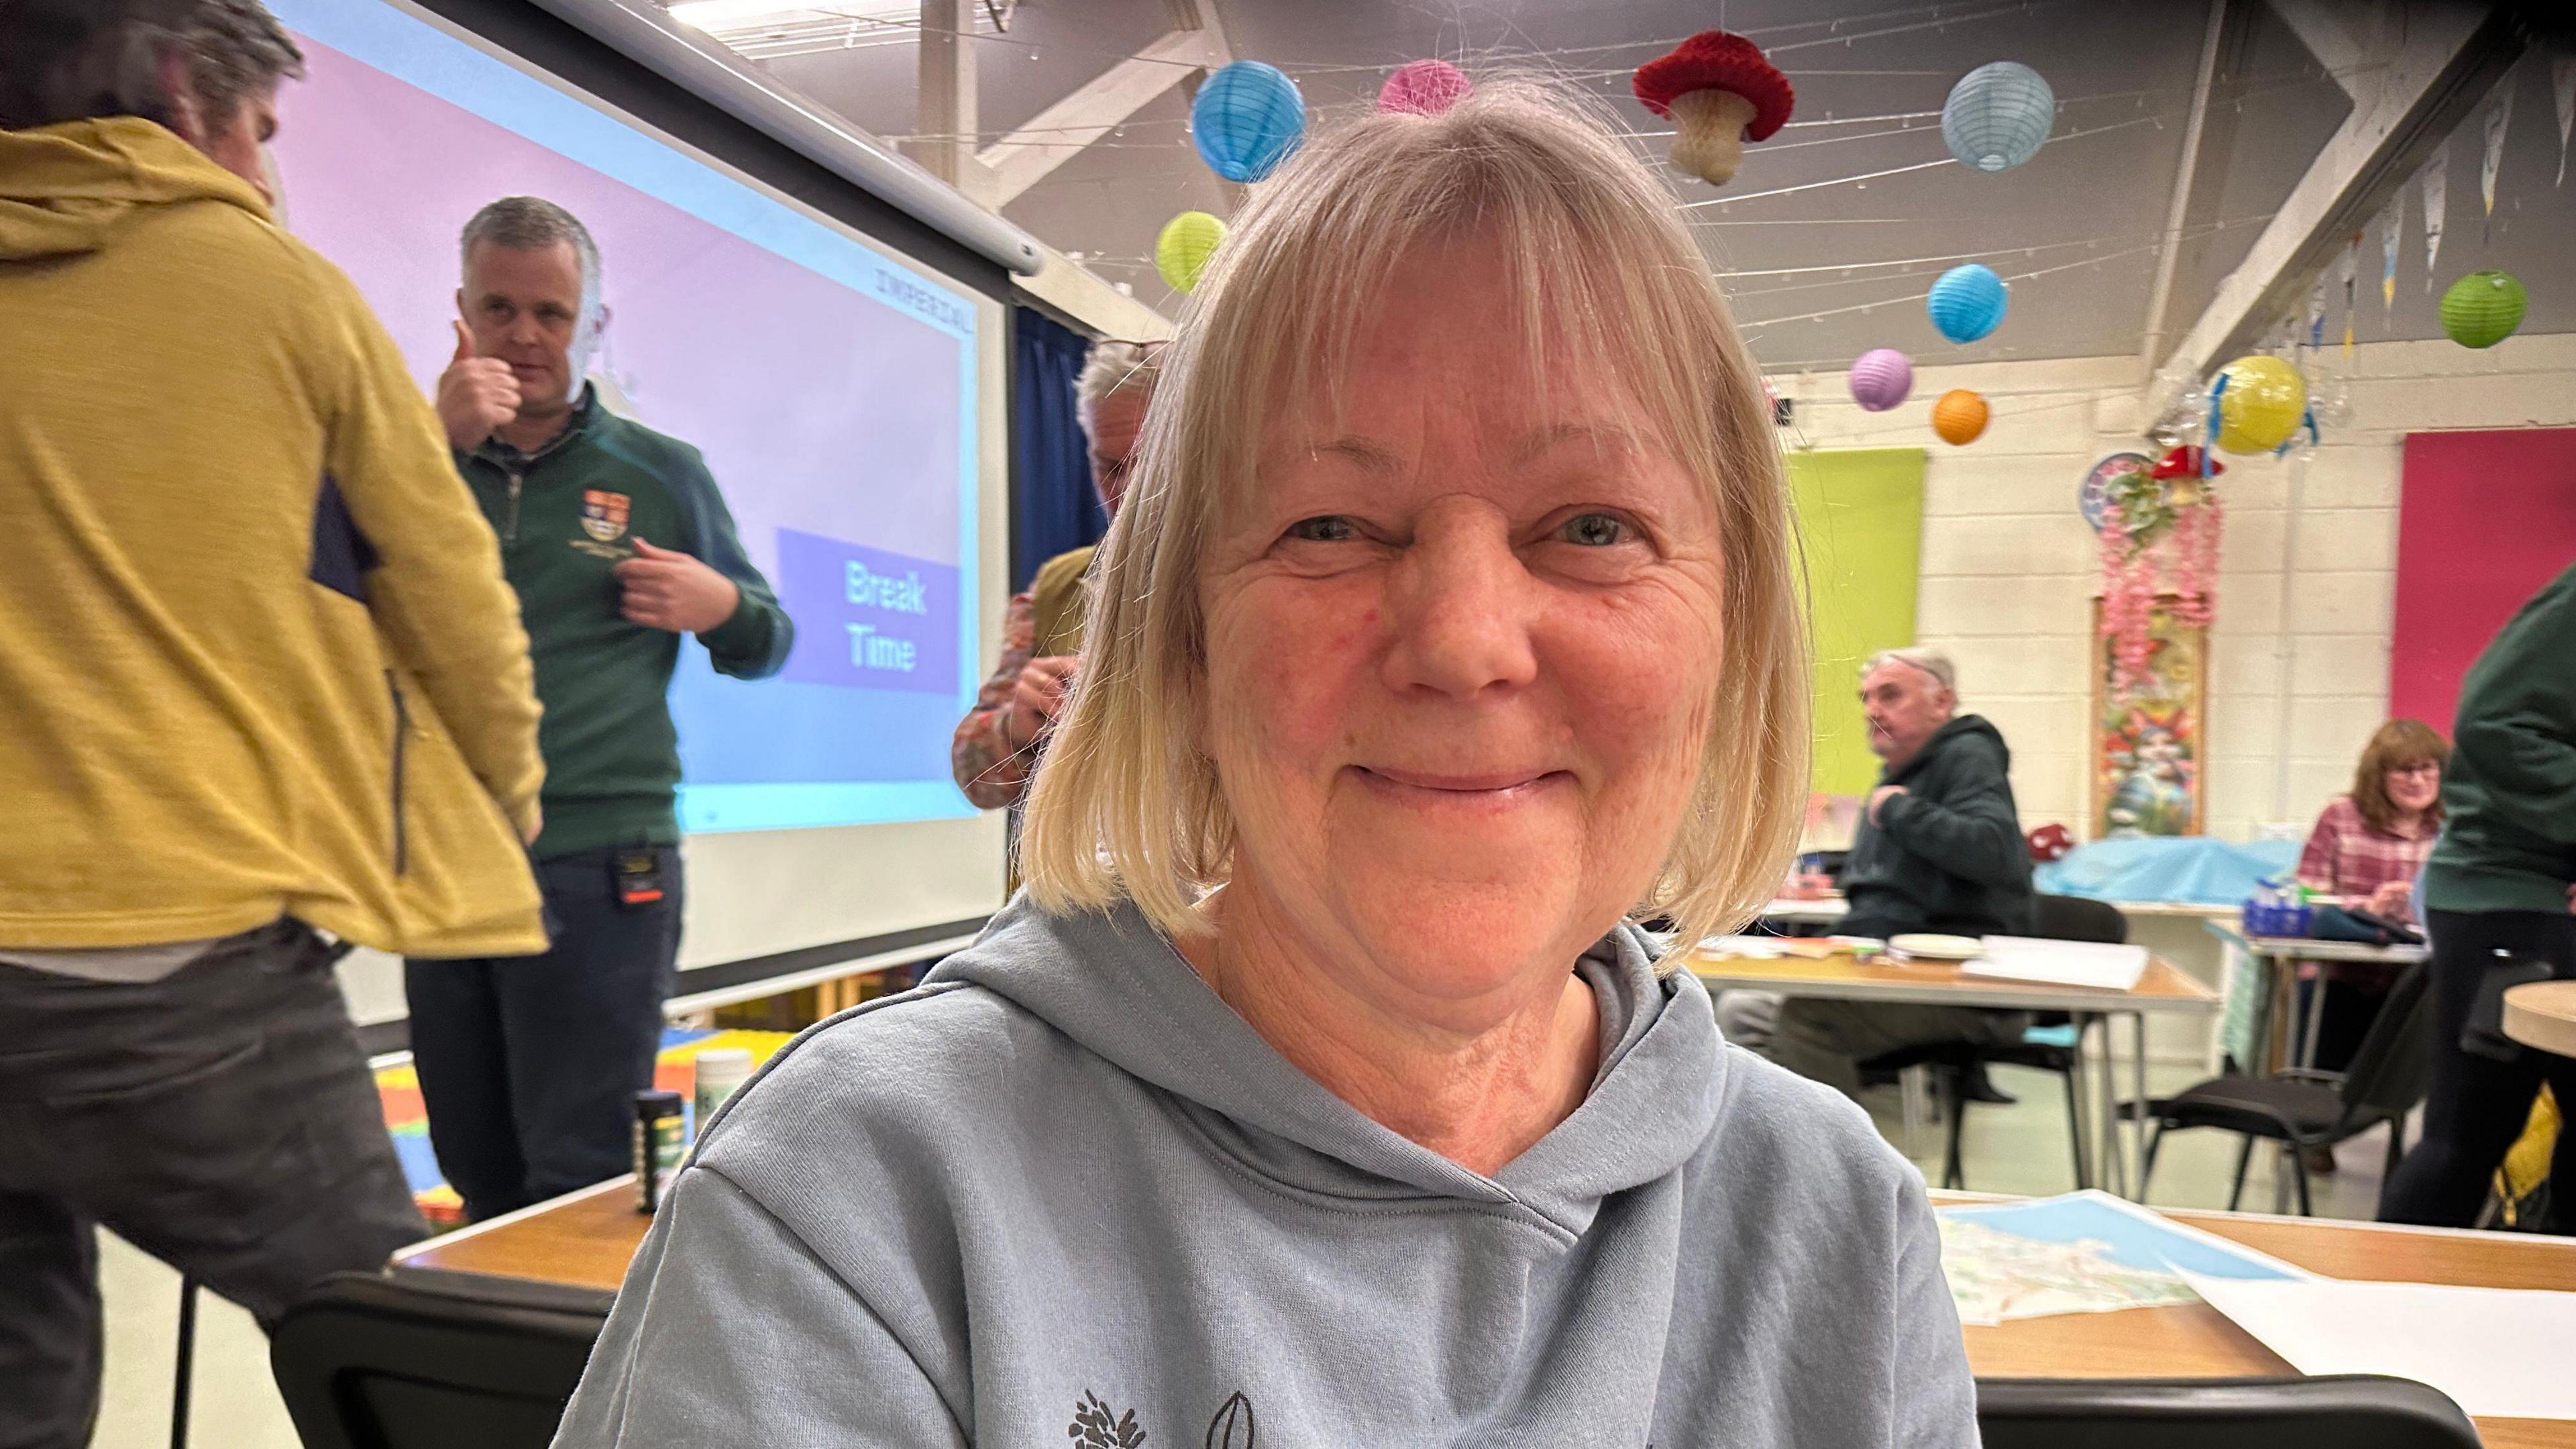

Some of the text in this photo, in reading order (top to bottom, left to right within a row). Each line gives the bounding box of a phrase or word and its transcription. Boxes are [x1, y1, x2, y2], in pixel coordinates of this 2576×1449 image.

[875, 268, 975, 334] IMPERIAL
[845, 559, 927, 616] Break
[844, 622, 916, 672] Time
